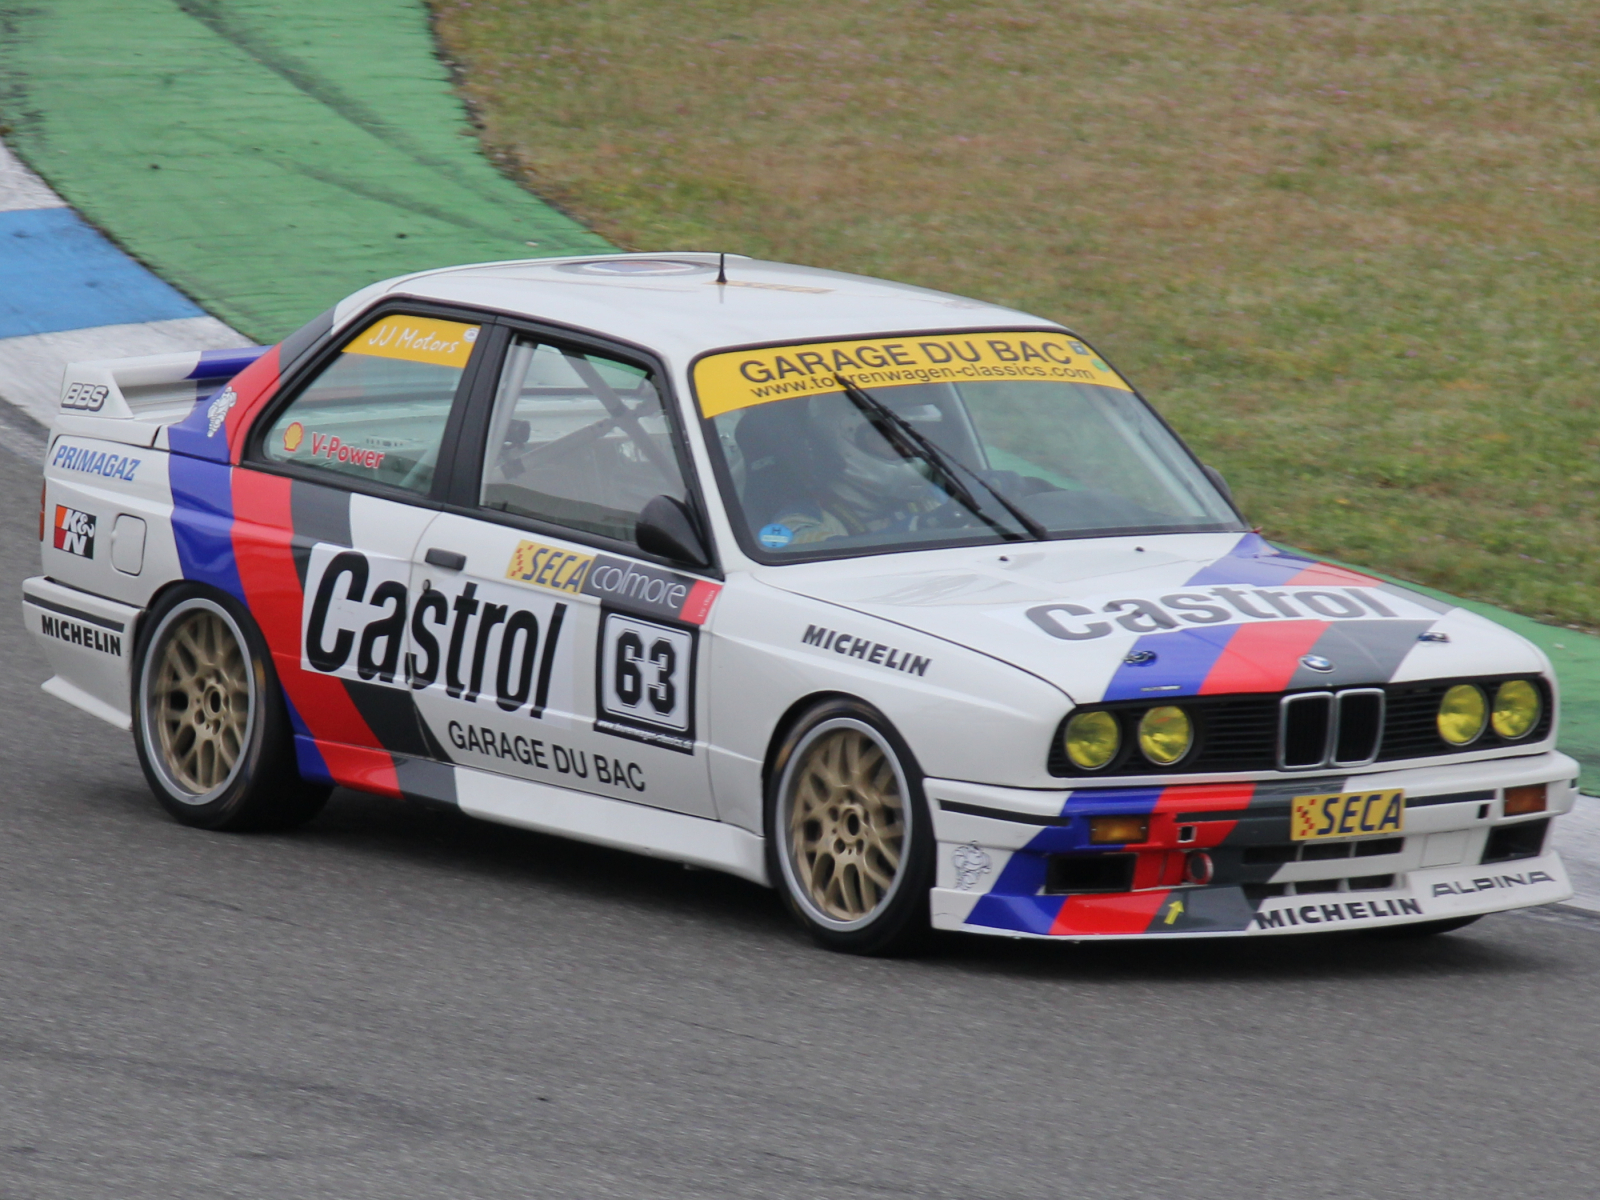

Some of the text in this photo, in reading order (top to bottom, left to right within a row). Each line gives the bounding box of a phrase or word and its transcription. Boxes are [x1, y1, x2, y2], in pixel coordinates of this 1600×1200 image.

[395, 327, 460, 354] Motors
[739, 340, 1073, 384] GARAGE DU BAC
[61, 382, 109, 412] BBS
[750, 359, 1096, 398] www.torenwagen-classics.com
[52, 445, 141, 482] PRIMAGAZ
[311, 431, 385, 469] V-Power
[522, 547, 591, 593] SECA
[591, 562, 687, 609] colmore
[305, 551, 568, 719] Castrol
[1025, 586, 1399, 641] Castrol
[41, 614, 121, 657] MICHELIN
[801, 624, 932, 677] MICHELIN
[614, 630, 676, 717] 63
[448, 720, 646, 792] GARAGE DU BAC
[1316, 794, 1401, 837] SECA
[1431, 870, 1558, 898] ALPINA
[1253, 898, 1424, 930] MICHELIN
